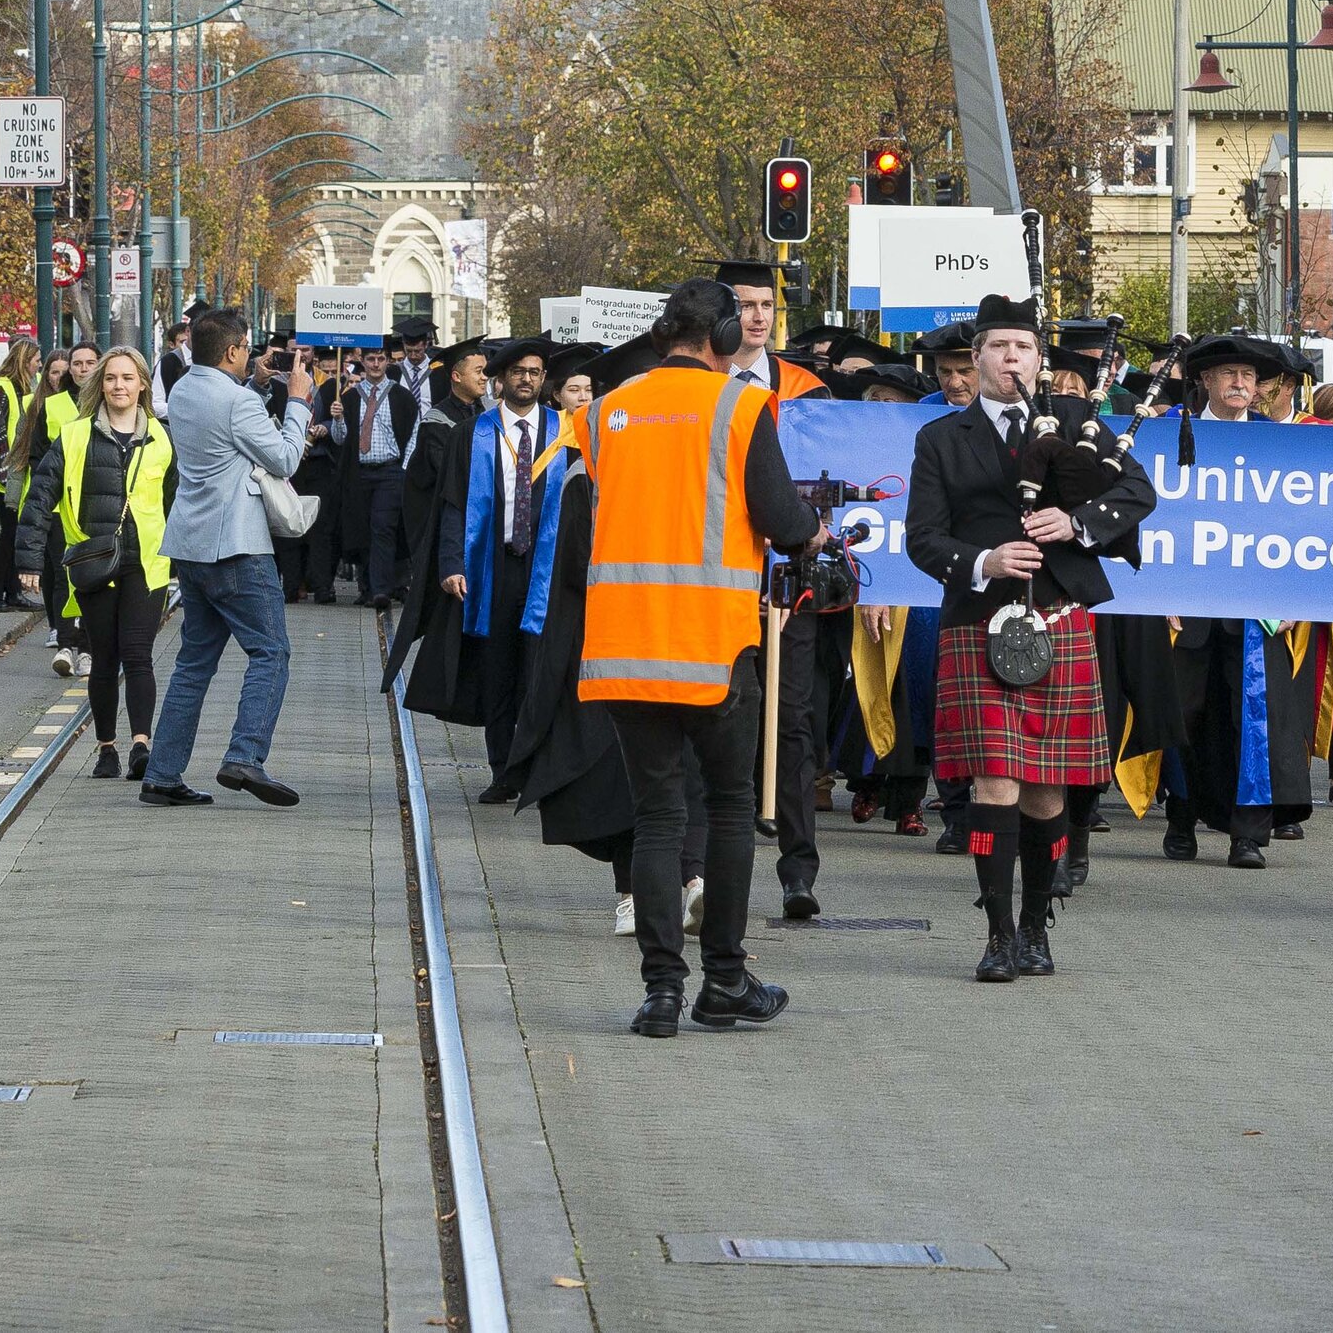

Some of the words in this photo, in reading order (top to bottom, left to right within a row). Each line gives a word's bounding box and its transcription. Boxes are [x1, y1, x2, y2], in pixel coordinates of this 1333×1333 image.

[22, 103, 37, 116] NO
[4, 119, 56, 132] CRUISING
[15, 135, 44, 147] ZONE
[10, 150, 50, 163] BEGINS
[312, 300, 355, 310] Bachelor
[357, 301, 367, 310] of
[585, 297, 642, 311] Postgraduate
[643, 302, 665, 312] Diplo
[312, 311, 367, 321] Commerce
[592, 321, 631, 331] Graduate
[602, 332, 608, 340] &
